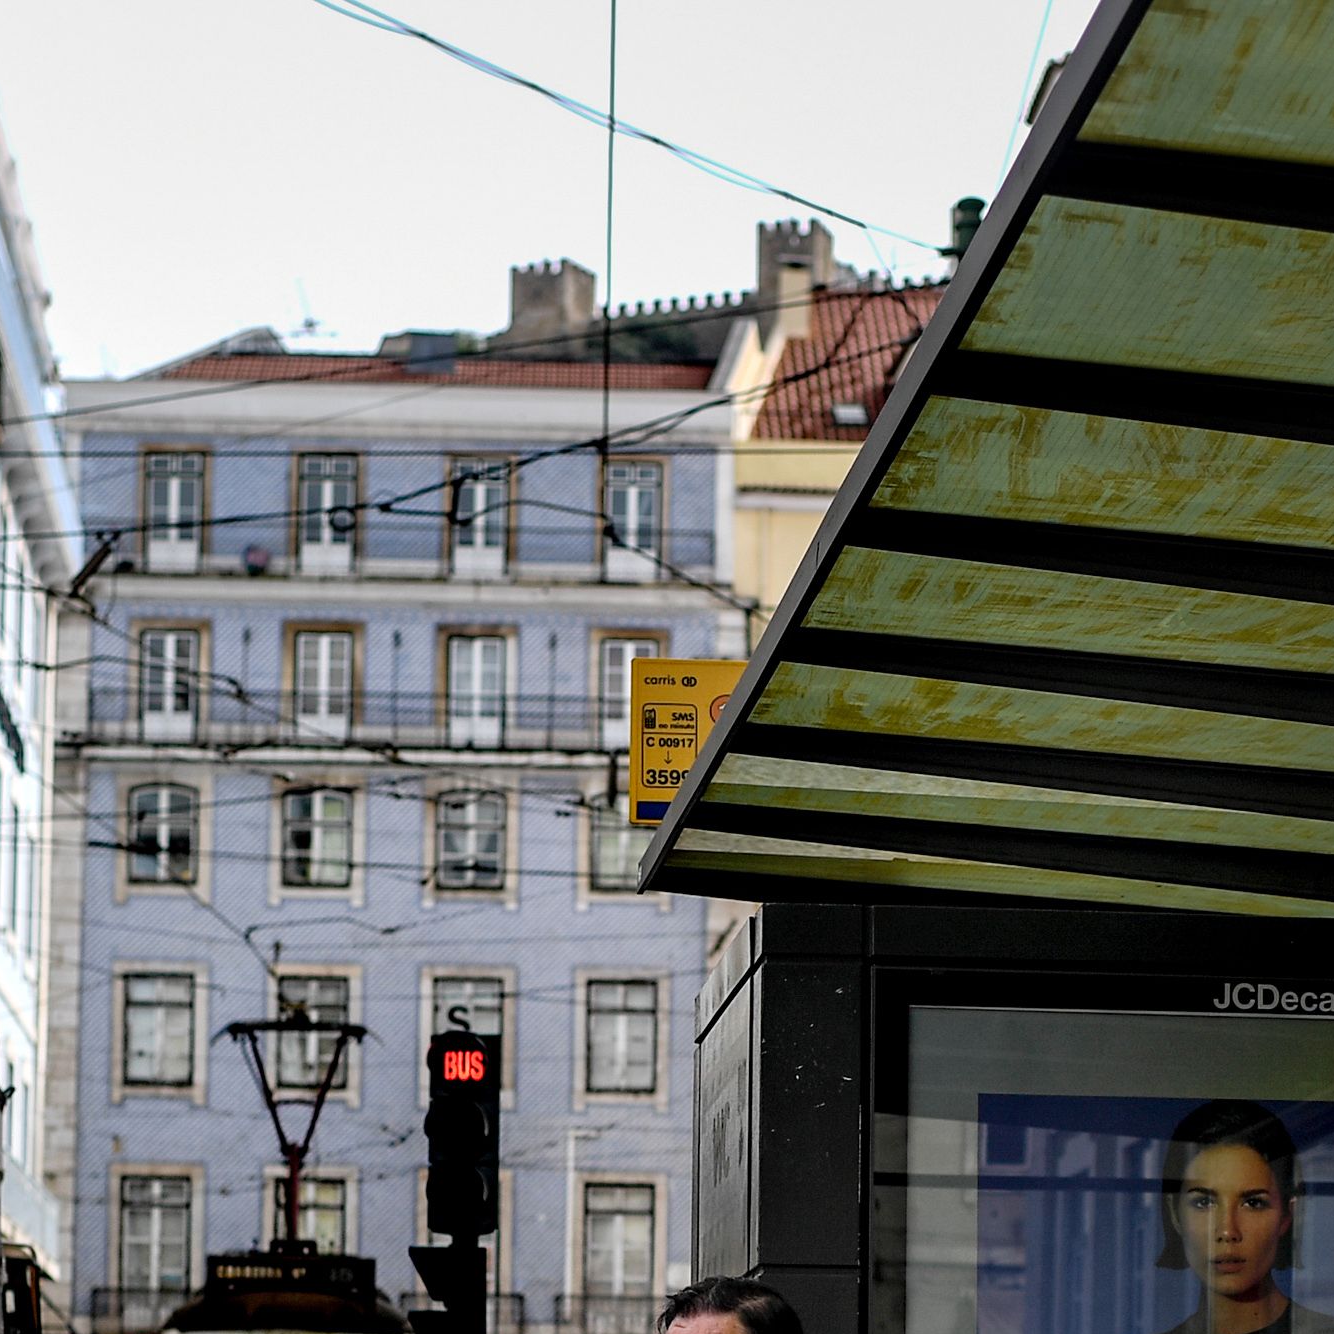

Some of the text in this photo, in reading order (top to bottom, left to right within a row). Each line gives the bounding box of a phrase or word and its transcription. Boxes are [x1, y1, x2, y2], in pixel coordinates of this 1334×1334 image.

[643, 674, 677, 686] carris
[671, 712, 695, 722] SMS
[646, 737, 694, 749] C 00917
[443, 1050, 485, 1082] BUS
